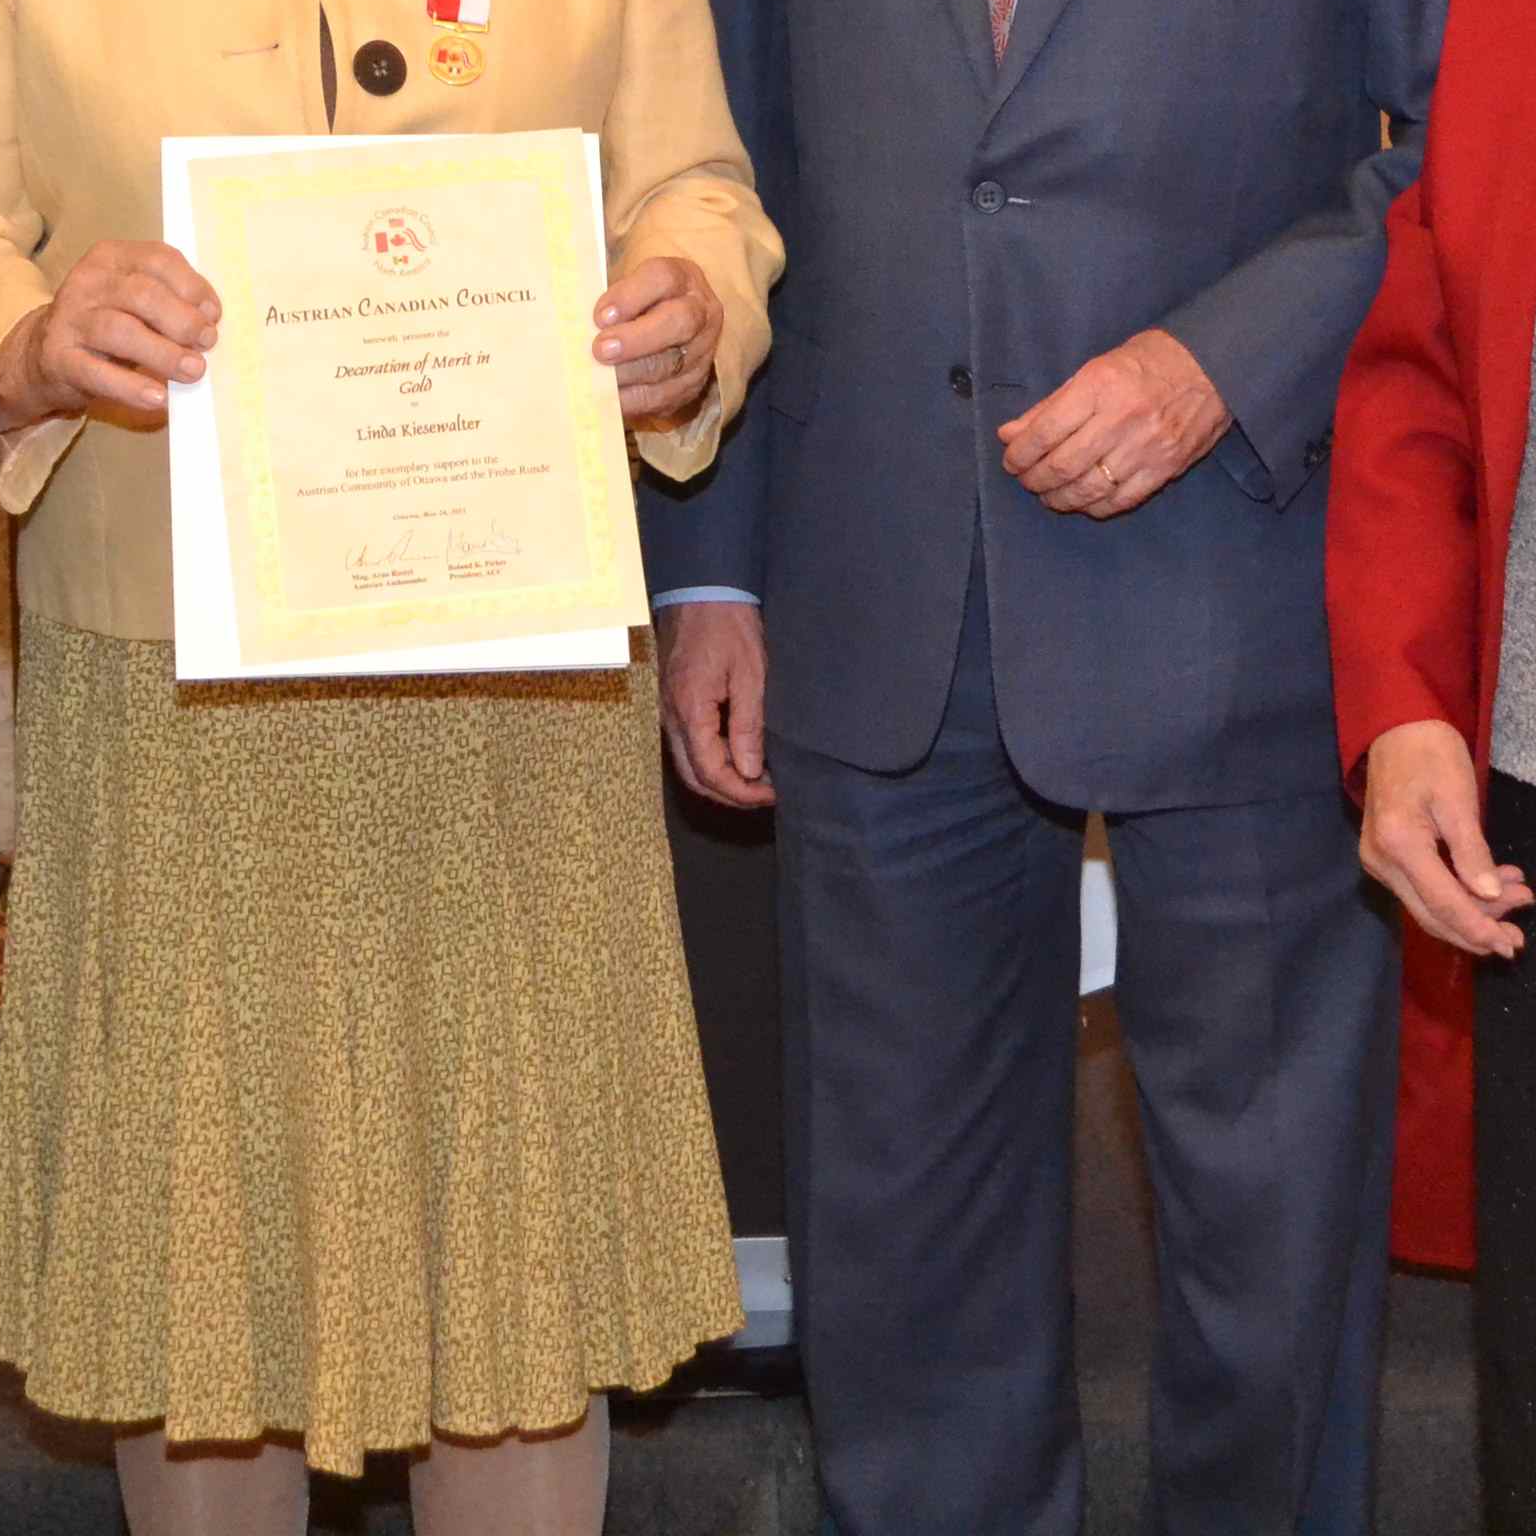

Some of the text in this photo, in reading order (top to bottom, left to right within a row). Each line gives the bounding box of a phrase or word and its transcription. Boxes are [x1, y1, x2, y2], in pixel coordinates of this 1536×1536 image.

[266, 288, 536, 327] AUSTRIAN CANADIAN COUNCIL
[334, 350, 491, 378] Decoration of Merit in
[399, 375, 433, 394] Gold
[356, 413, 481, 441] Linda Kiesewalter
[432, 460, 469, 473] support
[296, 484, 338, 497] Austrian
[340, 477, 397, 494] Community
[399, 476, 412, 488] of
[449, 471, 468, 481] and
[470, 469, 486, 480] the
